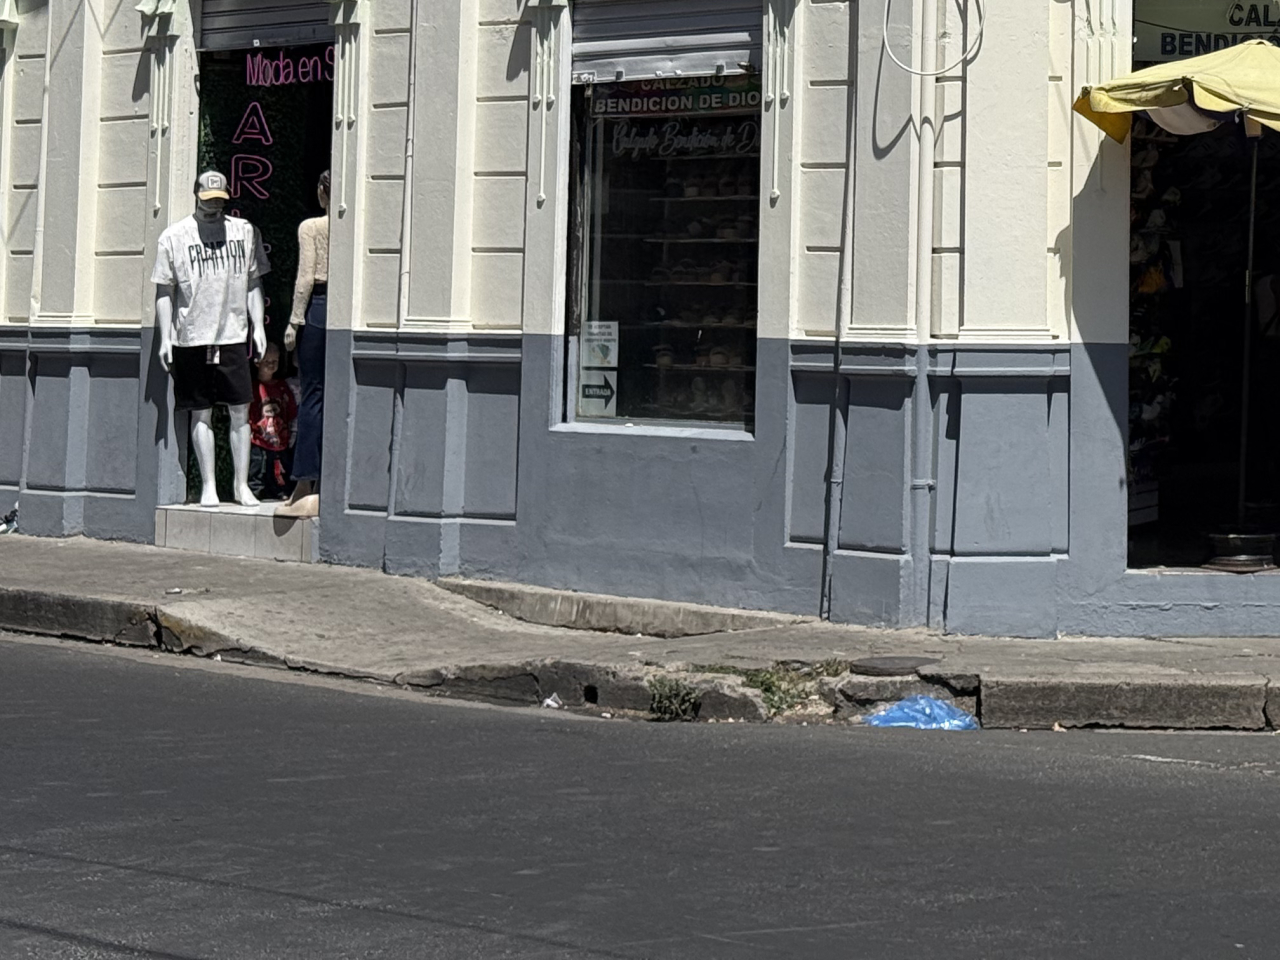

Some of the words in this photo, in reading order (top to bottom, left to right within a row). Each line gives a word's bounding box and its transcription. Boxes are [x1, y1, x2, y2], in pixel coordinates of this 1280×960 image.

[246, 51, 294, 87] Moda
[298, 57, 321, 82] en
[641, 76, 725, 90] CALZADO
[595, 95, 693, 113] BENDICION
[699, 93, 722, 109] DE
[188, 239, 246, 274] CREATION
[585, 388, 611, 396] ENTRADA
